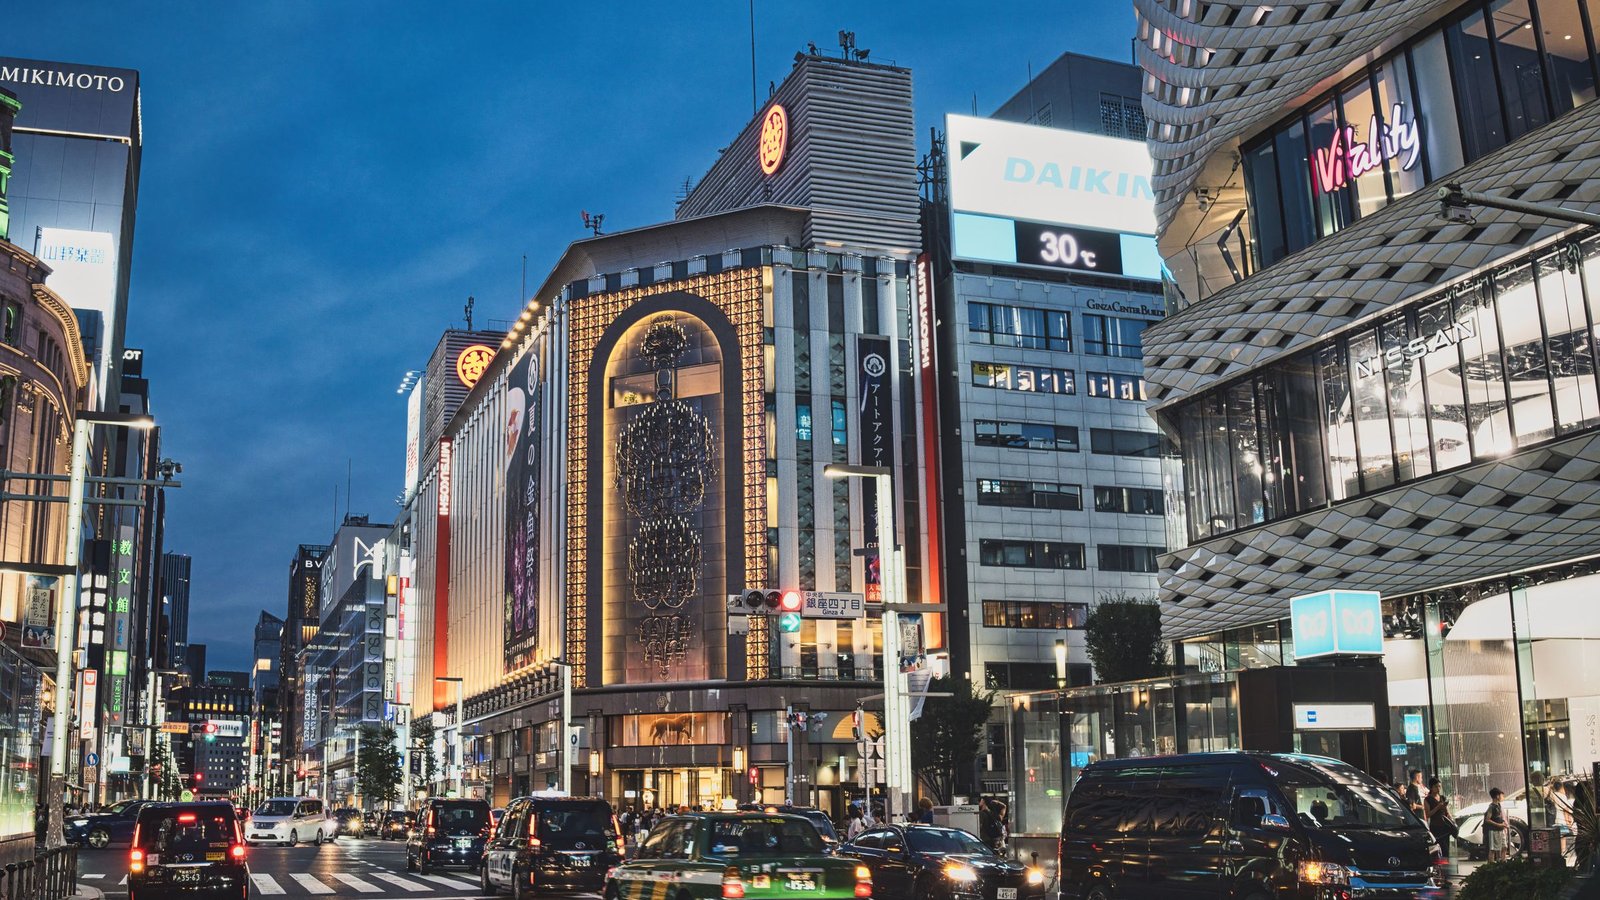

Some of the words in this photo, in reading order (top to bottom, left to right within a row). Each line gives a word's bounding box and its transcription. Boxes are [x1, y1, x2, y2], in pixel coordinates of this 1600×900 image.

[1, 66, 125, 92] MIKIMOTO
[1316, 103, 1421, 193] Vitality
[1003, 157, 1155, 201] DAIKIN
[917, 261, 931, 369] MITSUKOSHI
[1086, 299, 1112, 311] GINZA
[122, 350, 141, 360] OT
[1354, 316, 1477, 380] NISSAN
[438, 441, 451, 516] MITSUKOSHI
[116, 539, 132, 613] 教文館
[806, 598, 860, 609] 銀座四丁目
[822, 608, 839, 616] Ginza
[366, 677, 380, 719] GNZA
